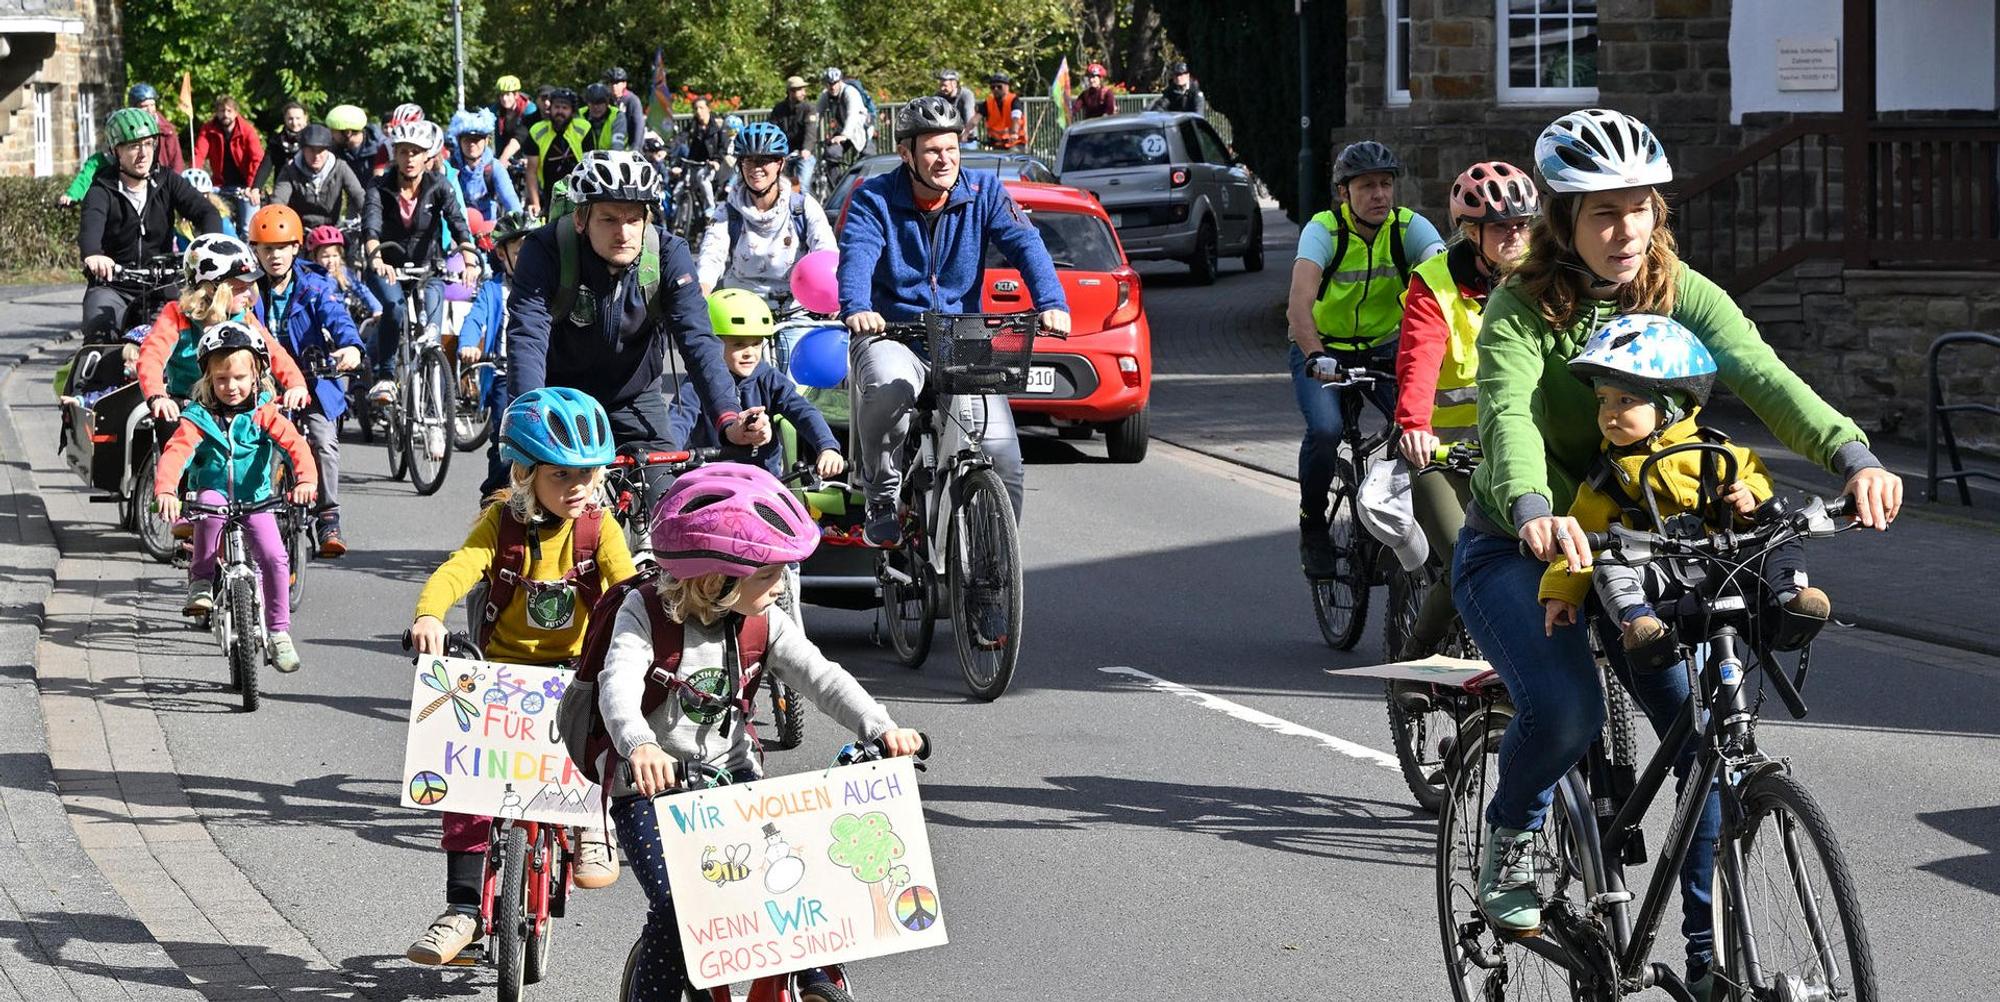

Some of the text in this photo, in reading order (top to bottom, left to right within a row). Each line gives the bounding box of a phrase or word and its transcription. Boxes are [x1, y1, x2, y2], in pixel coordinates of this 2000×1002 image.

[997, 281, 1016, 291] KIA
[545, 612, 570, 628] FUTURE
[483, 703, 536, 741] FÜR
[735, 786, 833, 822] WOLLEN
[843, 773, 902, 805] AUCH
[687, 911, 759, 945] WENN
[699, 941, 782, 979] GROSS
